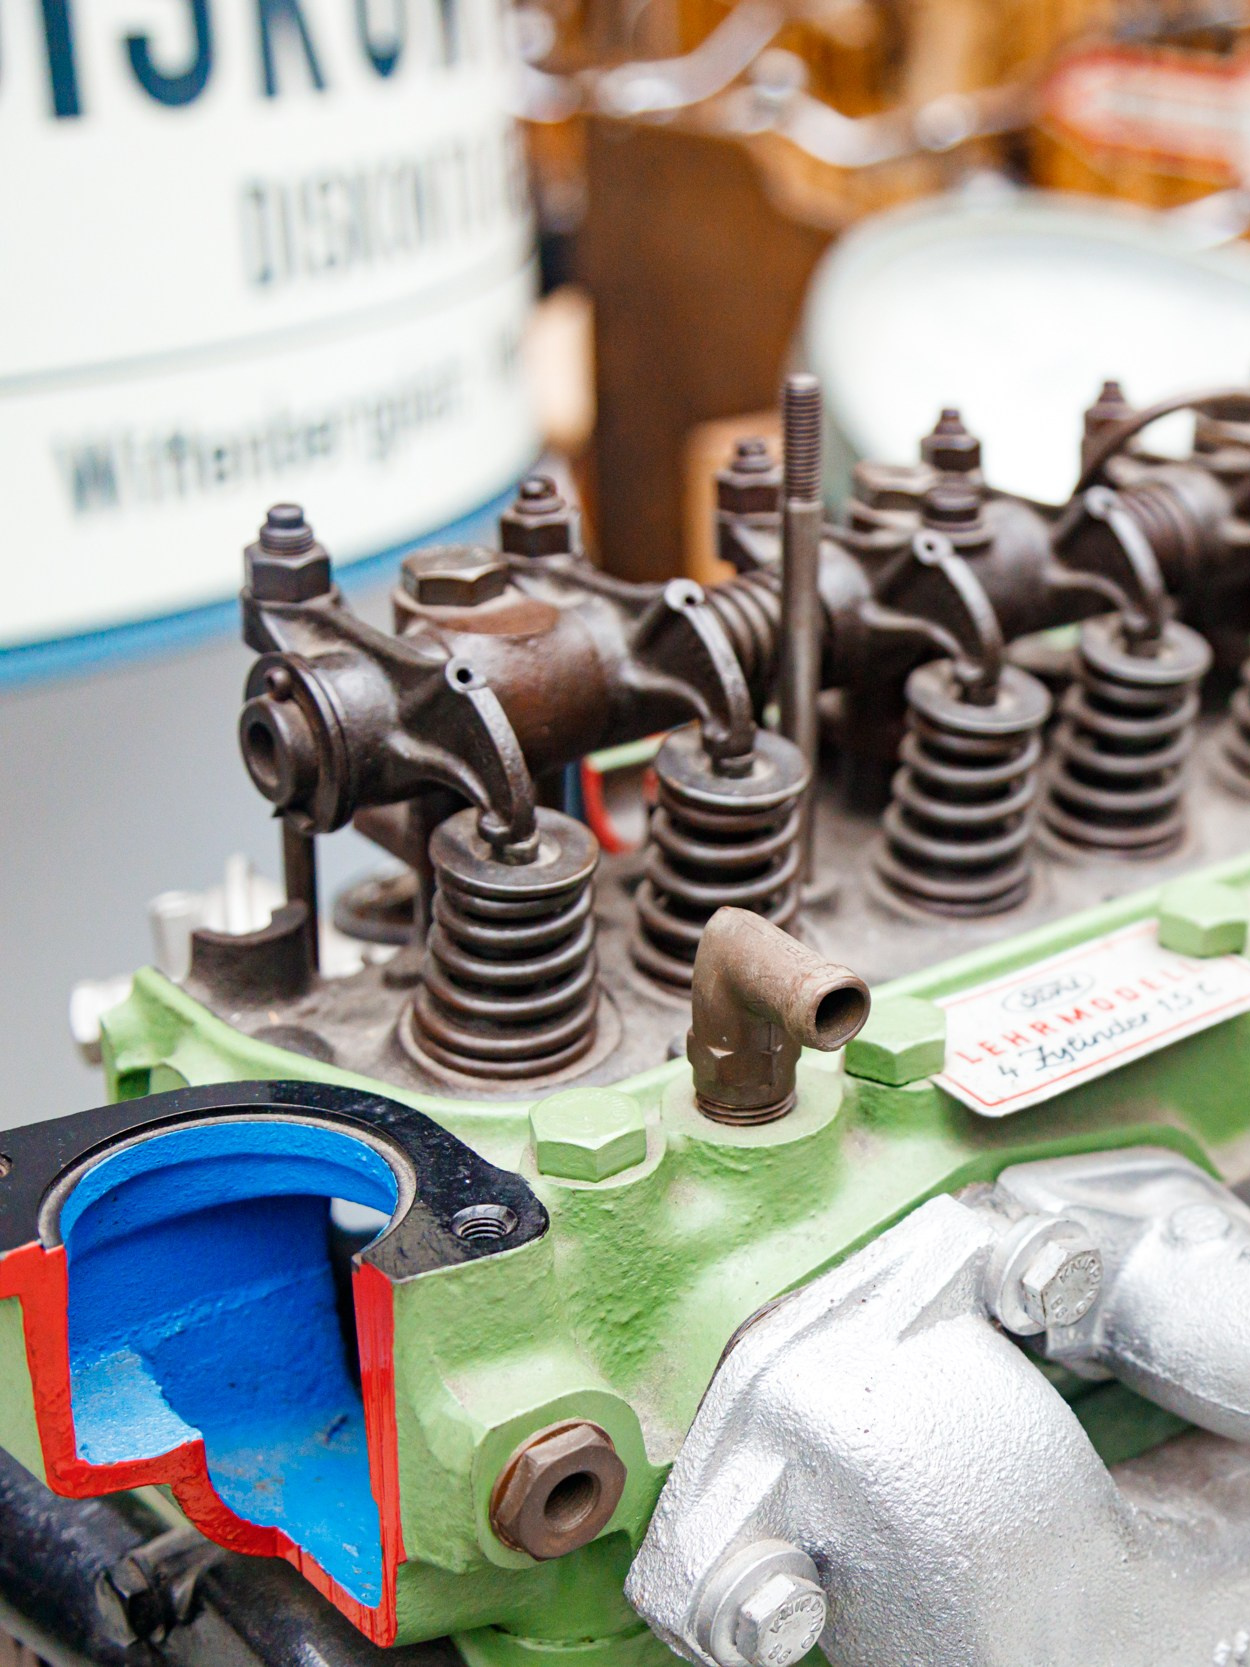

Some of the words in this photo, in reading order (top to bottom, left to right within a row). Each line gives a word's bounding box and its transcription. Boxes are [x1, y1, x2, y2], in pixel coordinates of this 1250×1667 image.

[954, 957, 1205, 1066] LEHRMODELL
[997, 1063, 1019, 1079] 4
[1018, 1011, 1150, 1073] Zylinder
